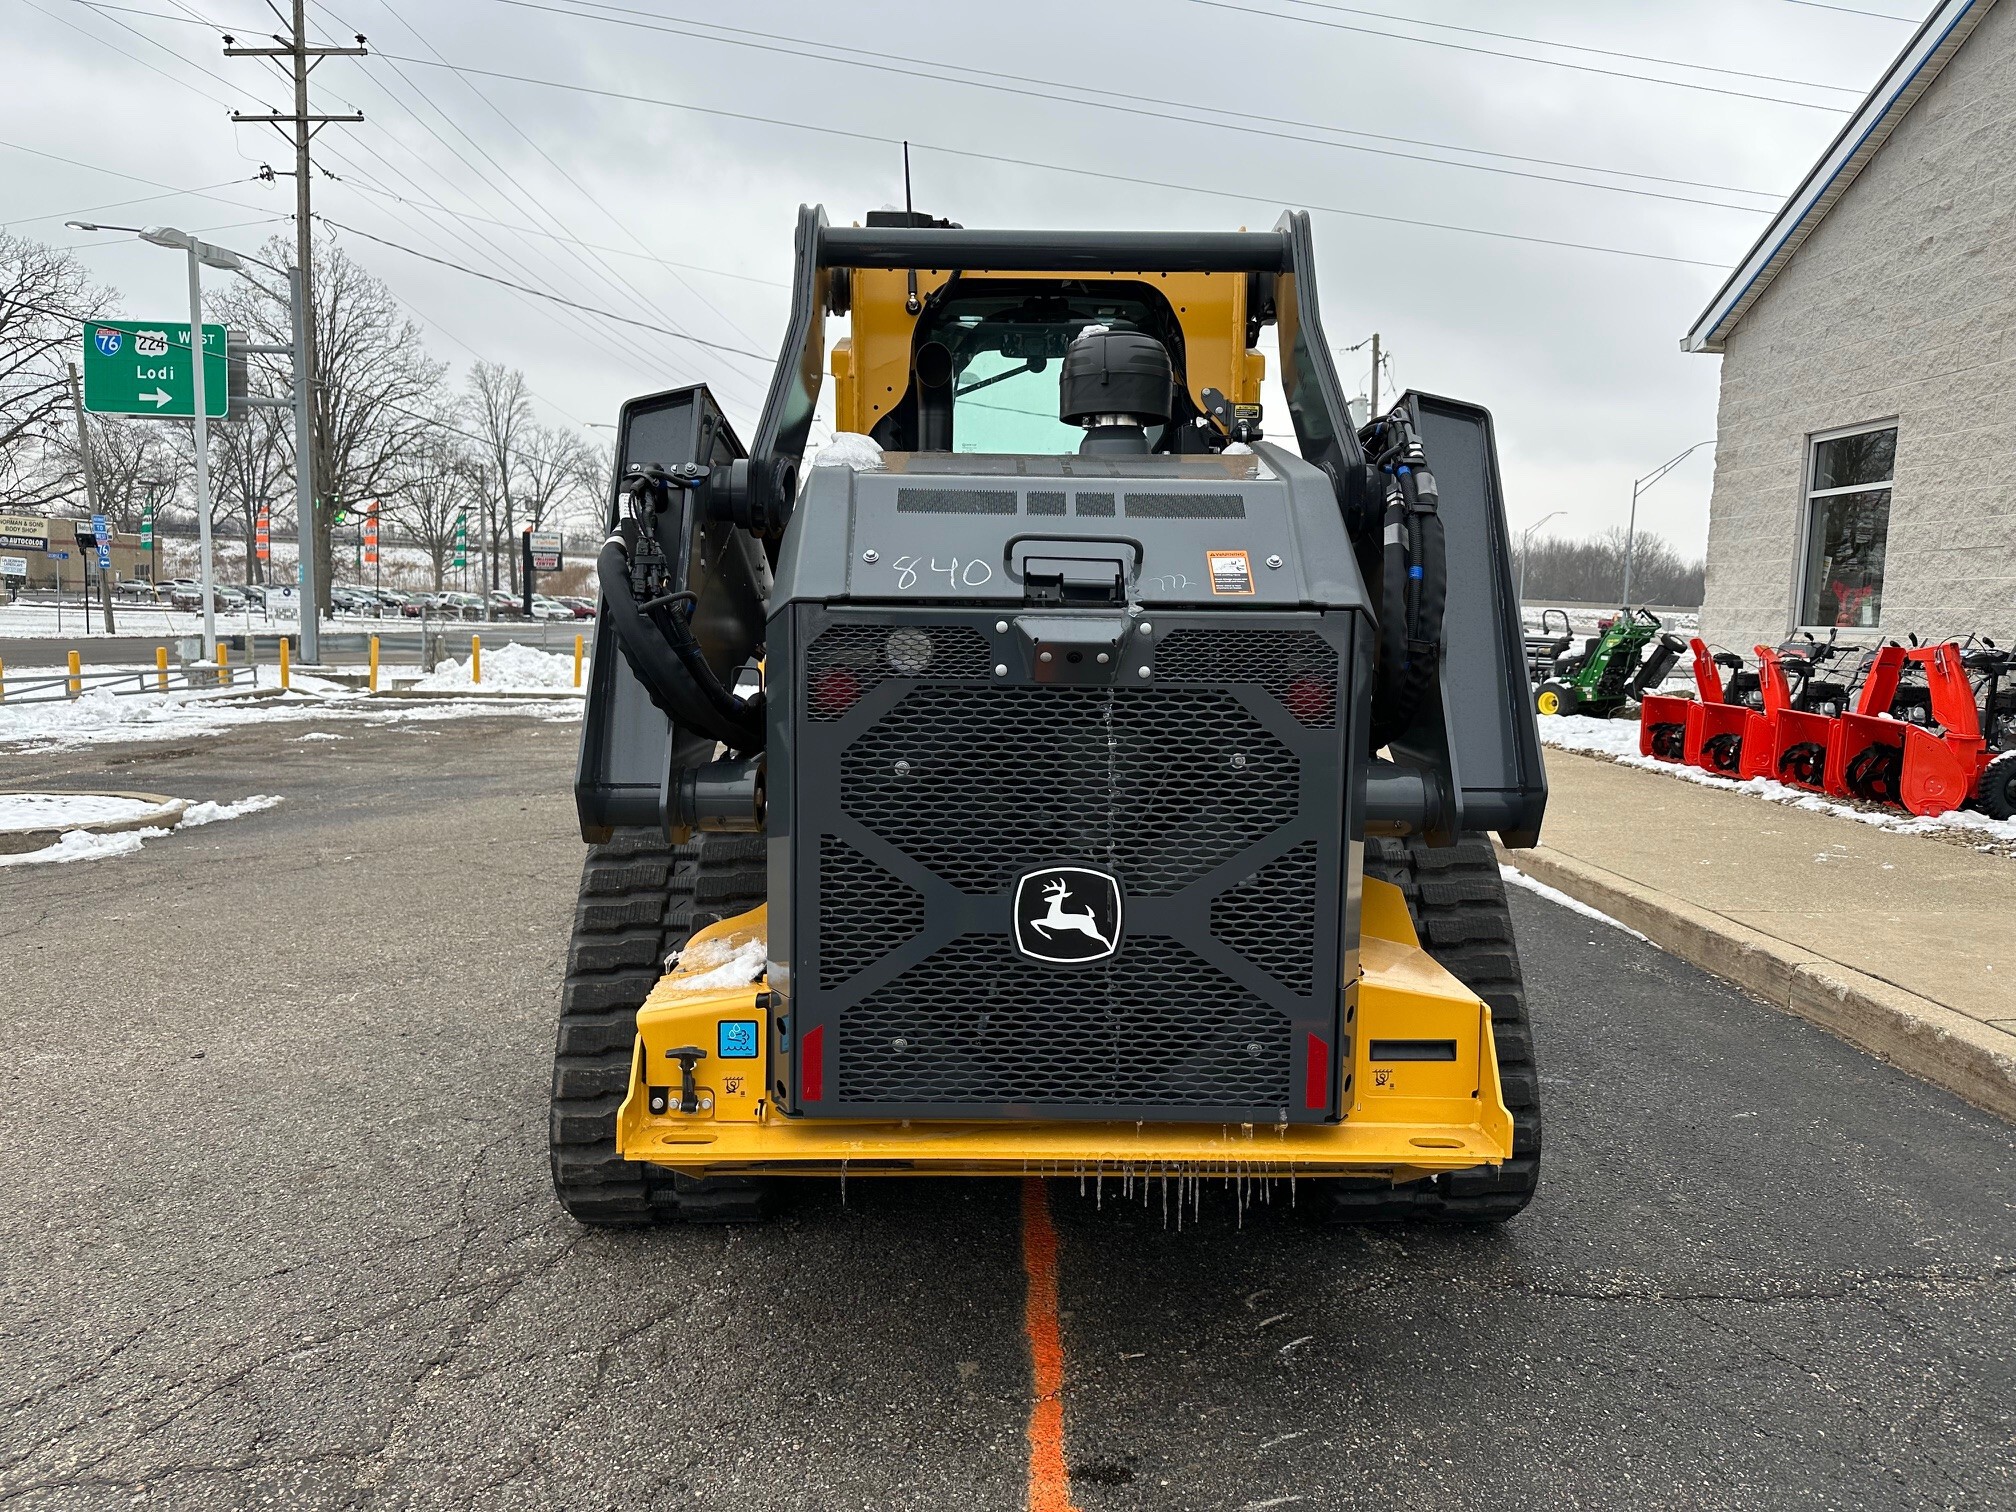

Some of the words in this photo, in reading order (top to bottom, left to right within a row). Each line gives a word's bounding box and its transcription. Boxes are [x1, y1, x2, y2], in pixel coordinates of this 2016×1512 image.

[98, 335, 119, 351] 76
[138, 336, 165, 351] 224
[178, 331, 215, 345] WST
[137, 365, 174, 380] Lodi
[9, 538, 44, 546] AUTOCOLOR
[99, 545, 108, 555] 76
[893, 556, 992, 590] 840
